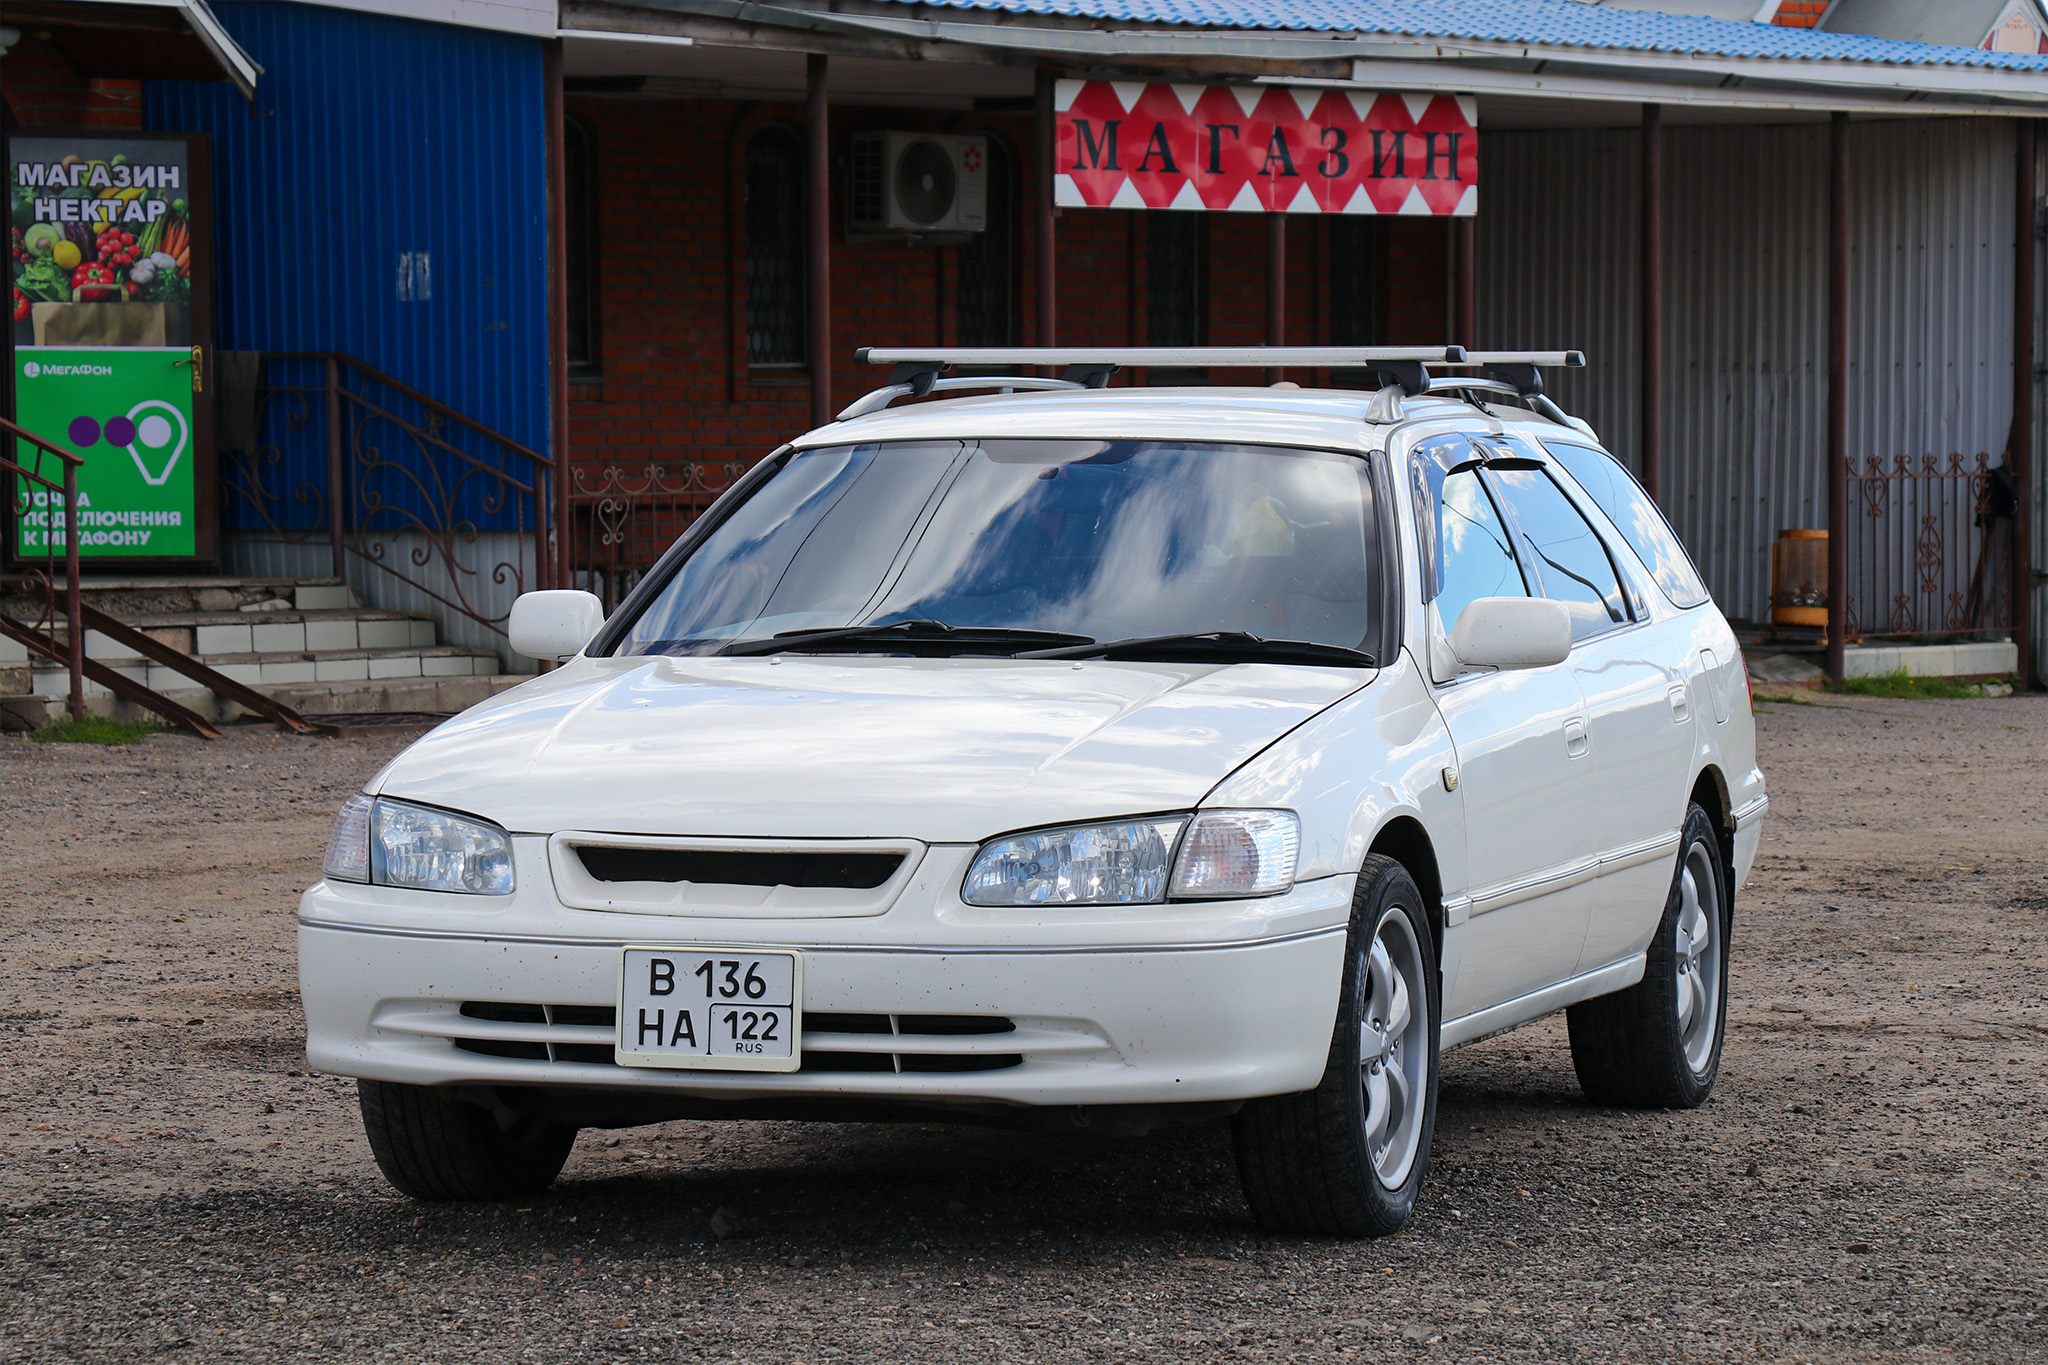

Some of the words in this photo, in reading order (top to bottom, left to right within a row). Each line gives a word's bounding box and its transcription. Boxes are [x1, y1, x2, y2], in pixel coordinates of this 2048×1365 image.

[1071, 118, 1464, 181] МАГАЗИН
[17, 162, 180, 188] МАГАЗИН
[34, 198, 167, 222] НЕКТАР
[22, 492, 91, 507] ТОЧА
[23, 530, 38, 546] К
[695, 960, 767, 999] 136
[723, 1010, 779, 1041] 122
[735, 1042, 763, 1054] RUS
